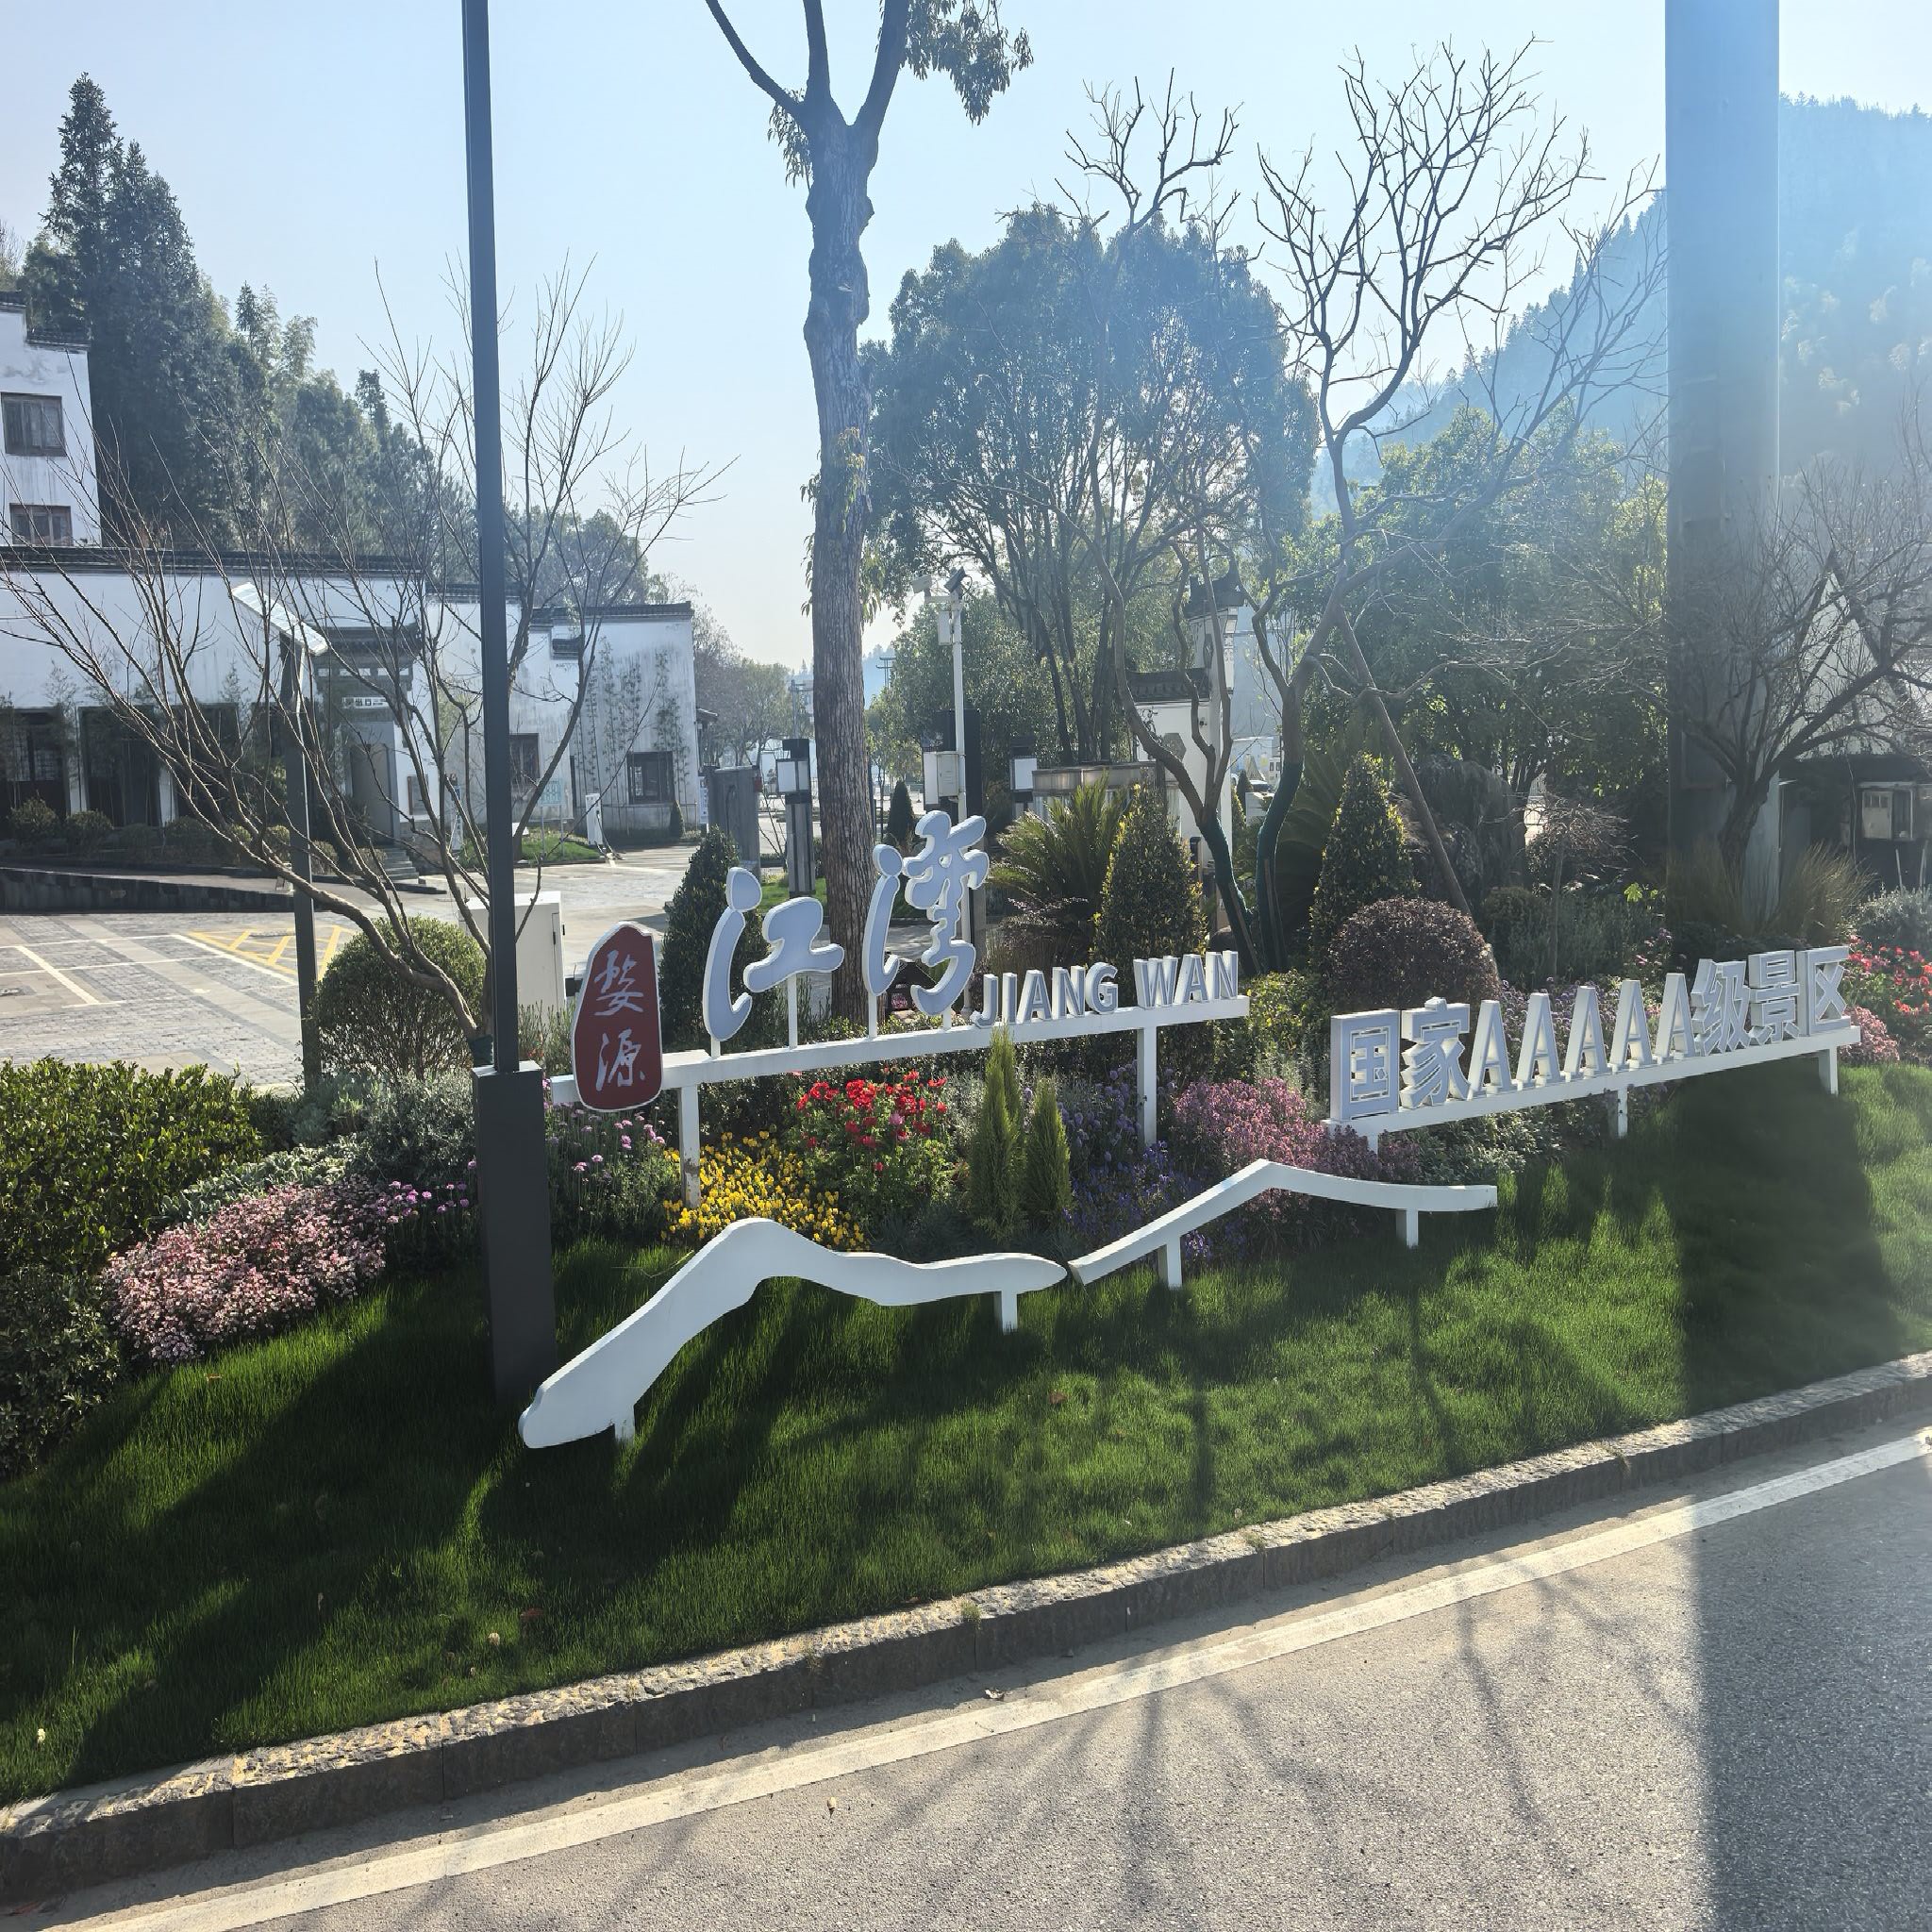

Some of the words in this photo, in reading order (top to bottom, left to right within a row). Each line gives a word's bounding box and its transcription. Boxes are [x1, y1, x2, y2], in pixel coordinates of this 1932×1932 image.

[594, 950, 644, 1091] 婺源
[970, 962, 1118, 1028] JIANG
[1133, 950, 1239, 1008] WAN
[1330, 945, 1851, 1120] 国家AAAAA级景区
